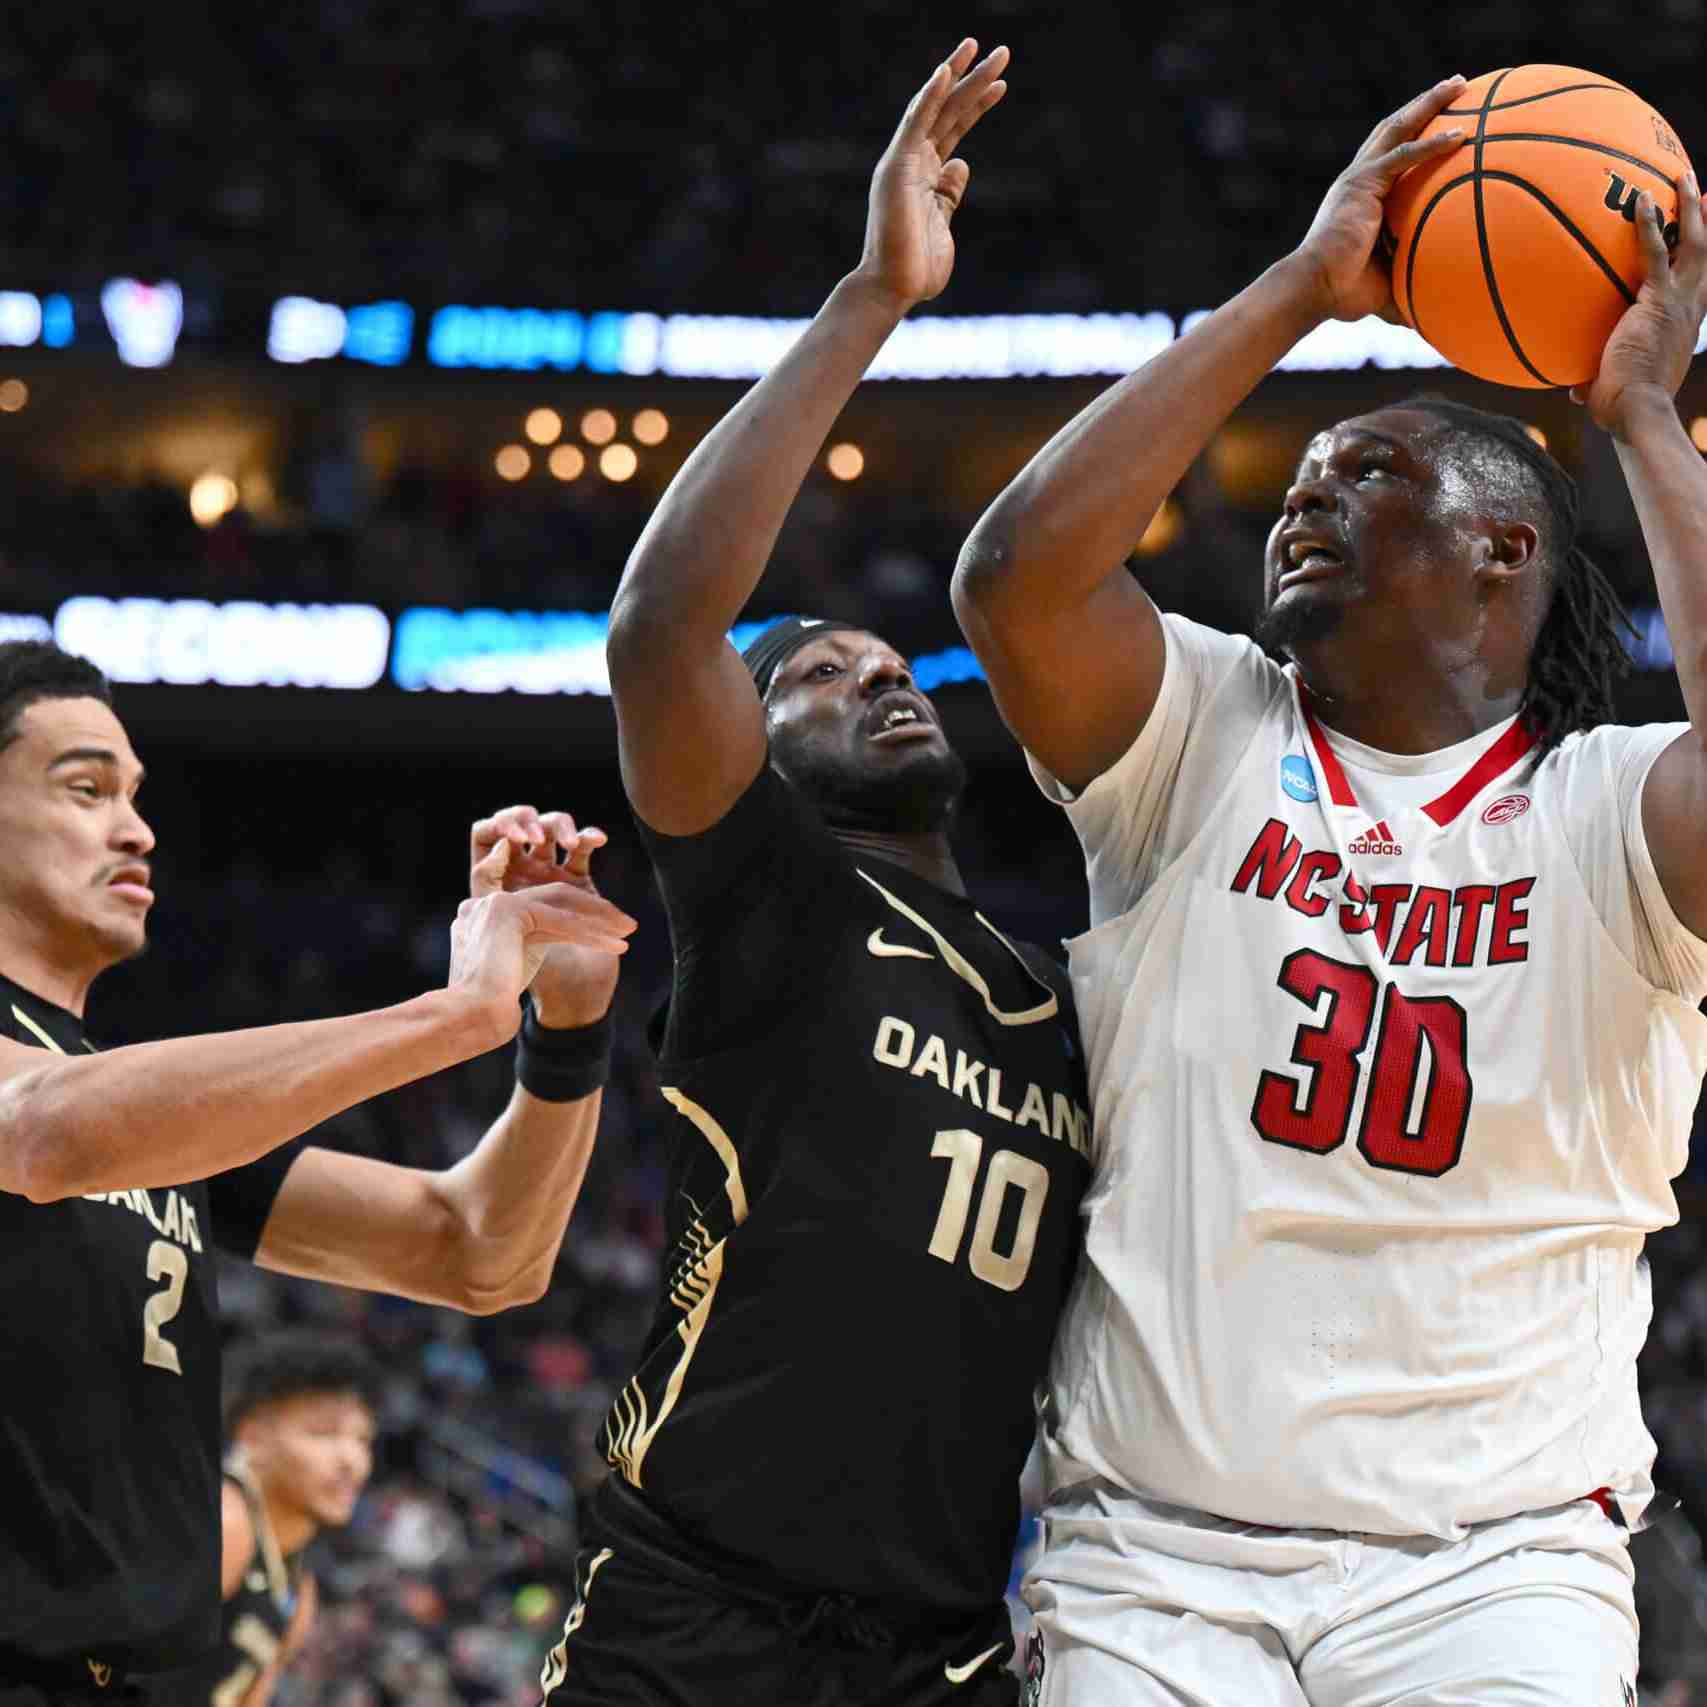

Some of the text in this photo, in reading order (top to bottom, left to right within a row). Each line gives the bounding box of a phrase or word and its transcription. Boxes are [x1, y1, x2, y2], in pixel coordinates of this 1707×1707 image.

[1230, 817, 1538, 969] NC STATE
[1348, 840, 1403, 856] adidas
[1250, 946, 1474, 1179] 30
[927, 1128, 1050, 1292] 10
[143, 1239, 188, 1376] 2
